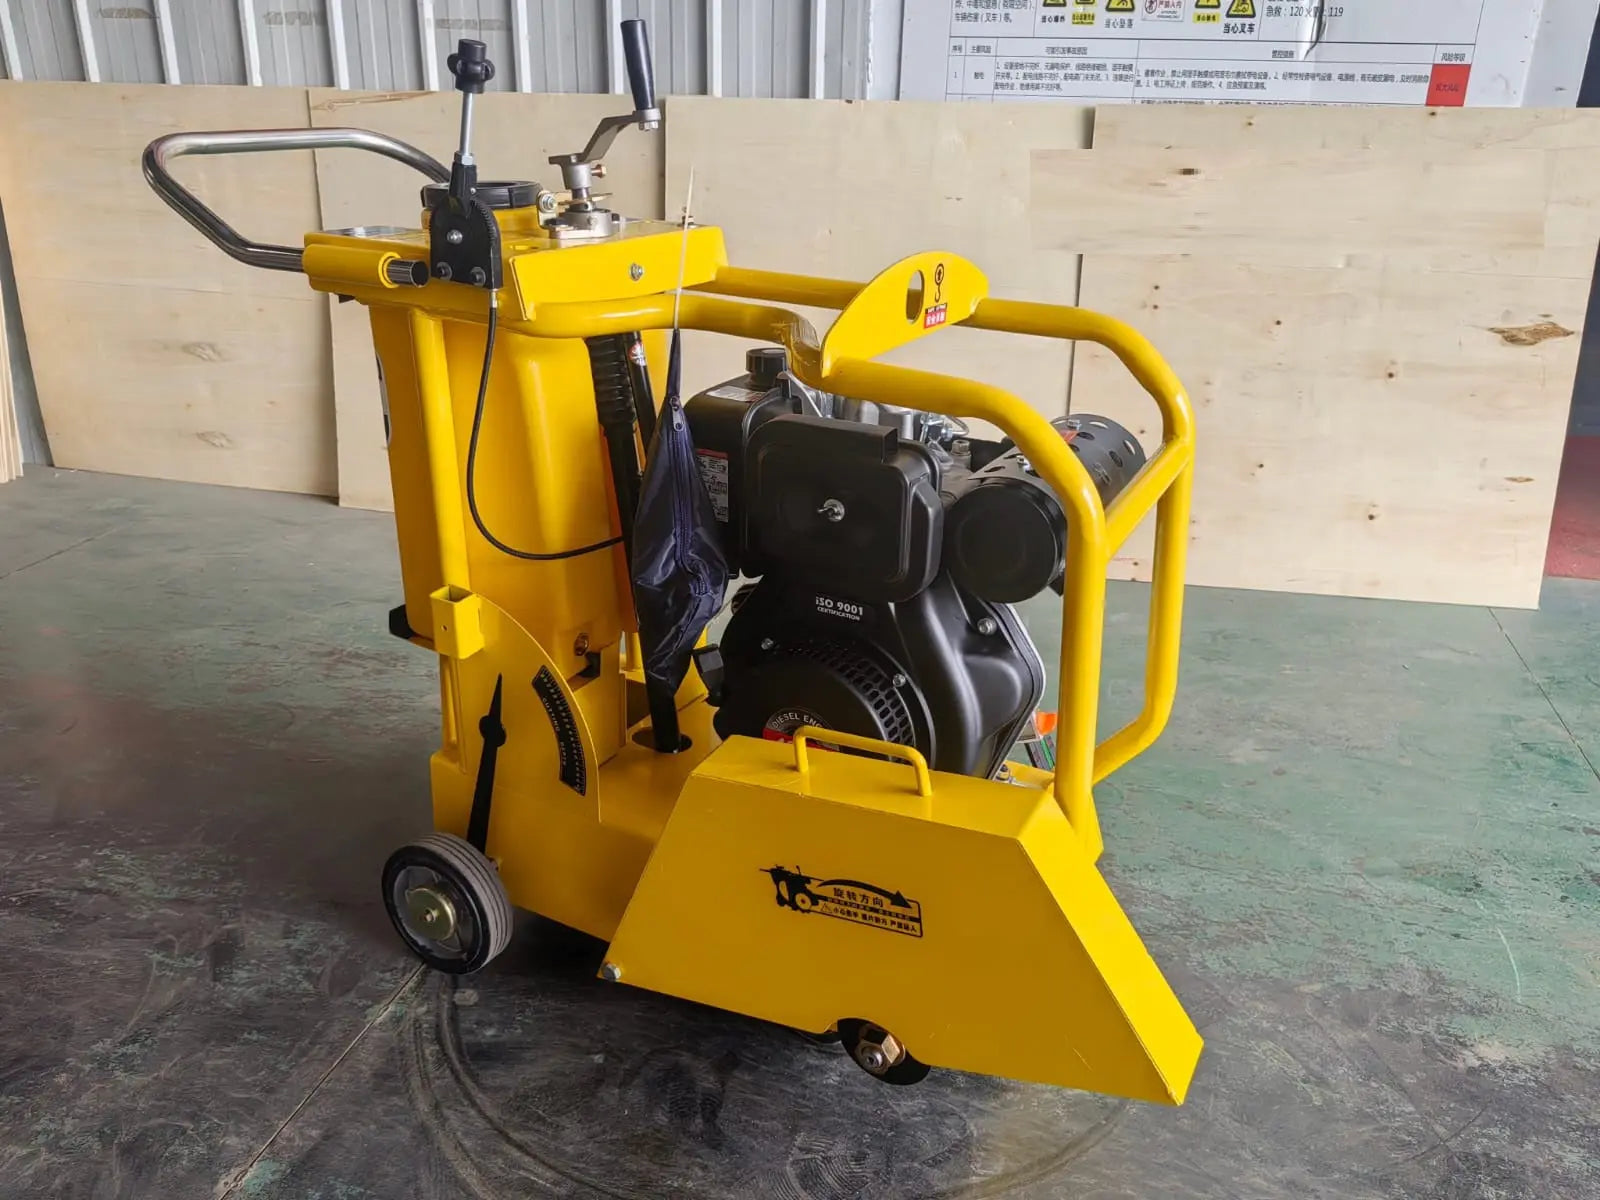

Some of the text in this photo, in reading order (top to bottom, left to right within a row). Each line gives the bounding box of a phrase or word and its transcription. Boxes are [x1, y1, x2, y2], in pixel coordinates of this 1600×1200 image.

[1223, 23, 1256, 34] 当心叉车
[836, 601, 864, 616] 9001
[771, 712, 801, 729] DIESEL
[833, 887, 884, 908] 旋转方向
